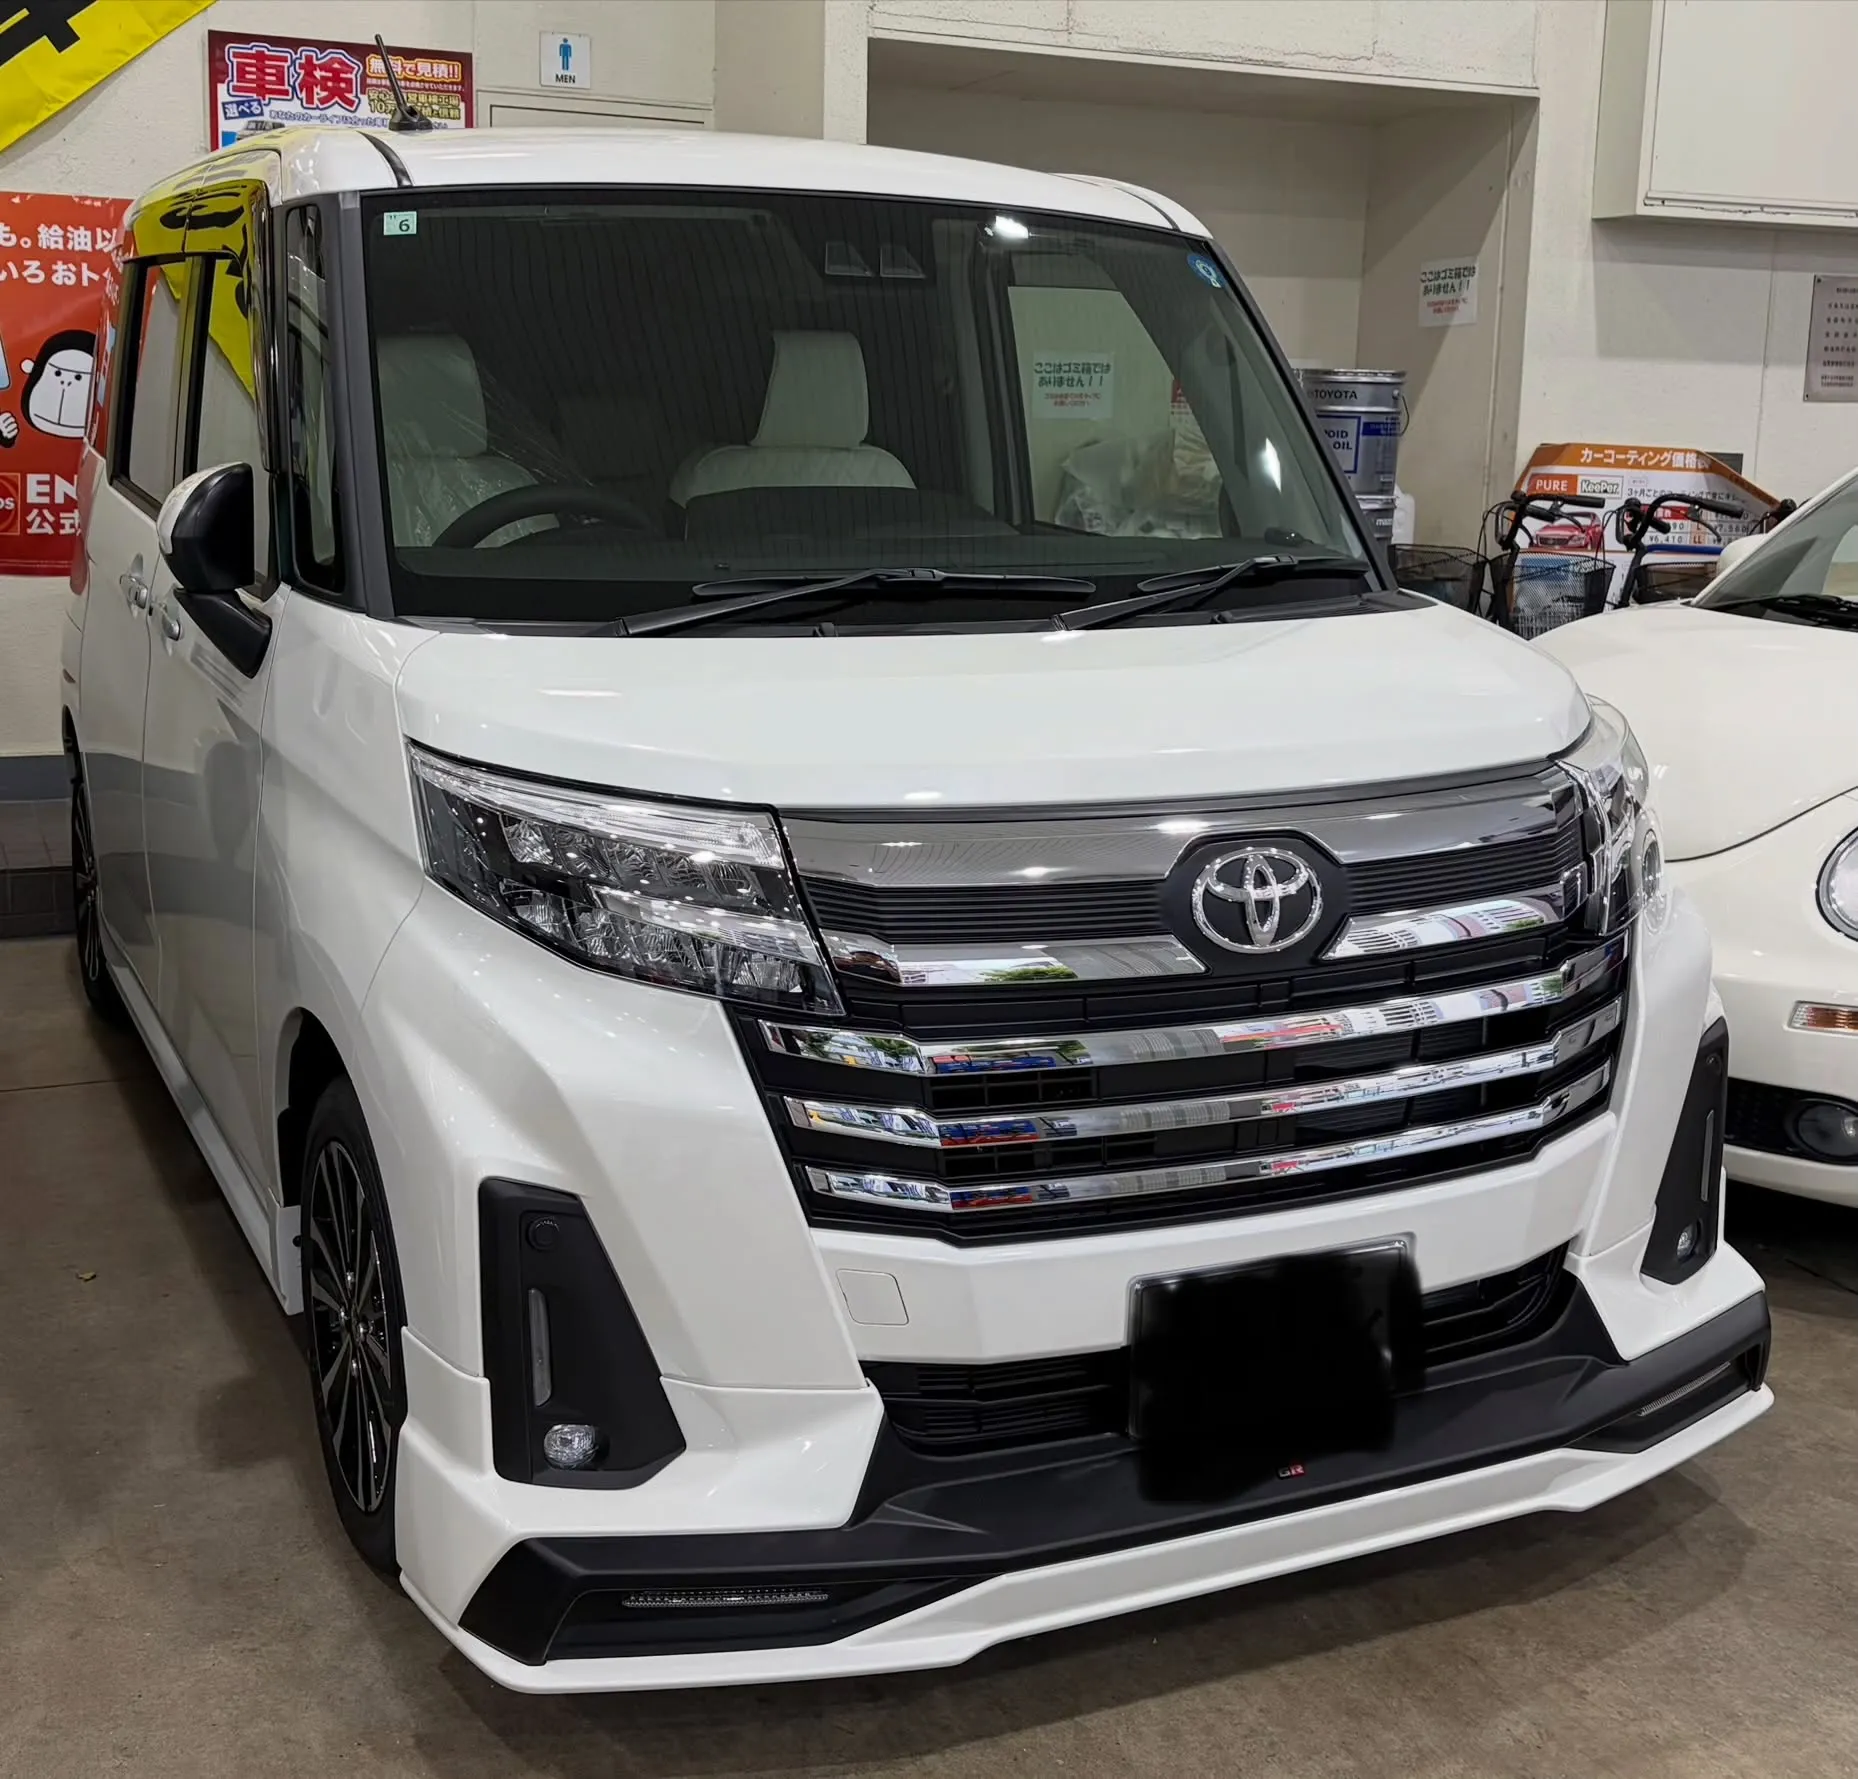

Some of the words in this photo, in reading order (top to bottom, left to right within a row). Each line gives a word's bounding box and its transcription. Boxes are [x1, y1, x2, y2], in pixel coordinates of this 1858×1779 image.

[228, 46, 361, 112] 車検
[555, 73, 576, 83] MEN
[225, 100, 262, 118] 選べる
[399, 219, 410, 232] 6
[1314, 389, 1357, 400] TOYOTA
[1325, 430, 1348, 439] OID
[1333, 441, 1353, 450] OIL
[1536, 480, 1569, 491] PURE
[26, 508, 81, 536] 公式
[1693, 535, 1703, 544] LL
